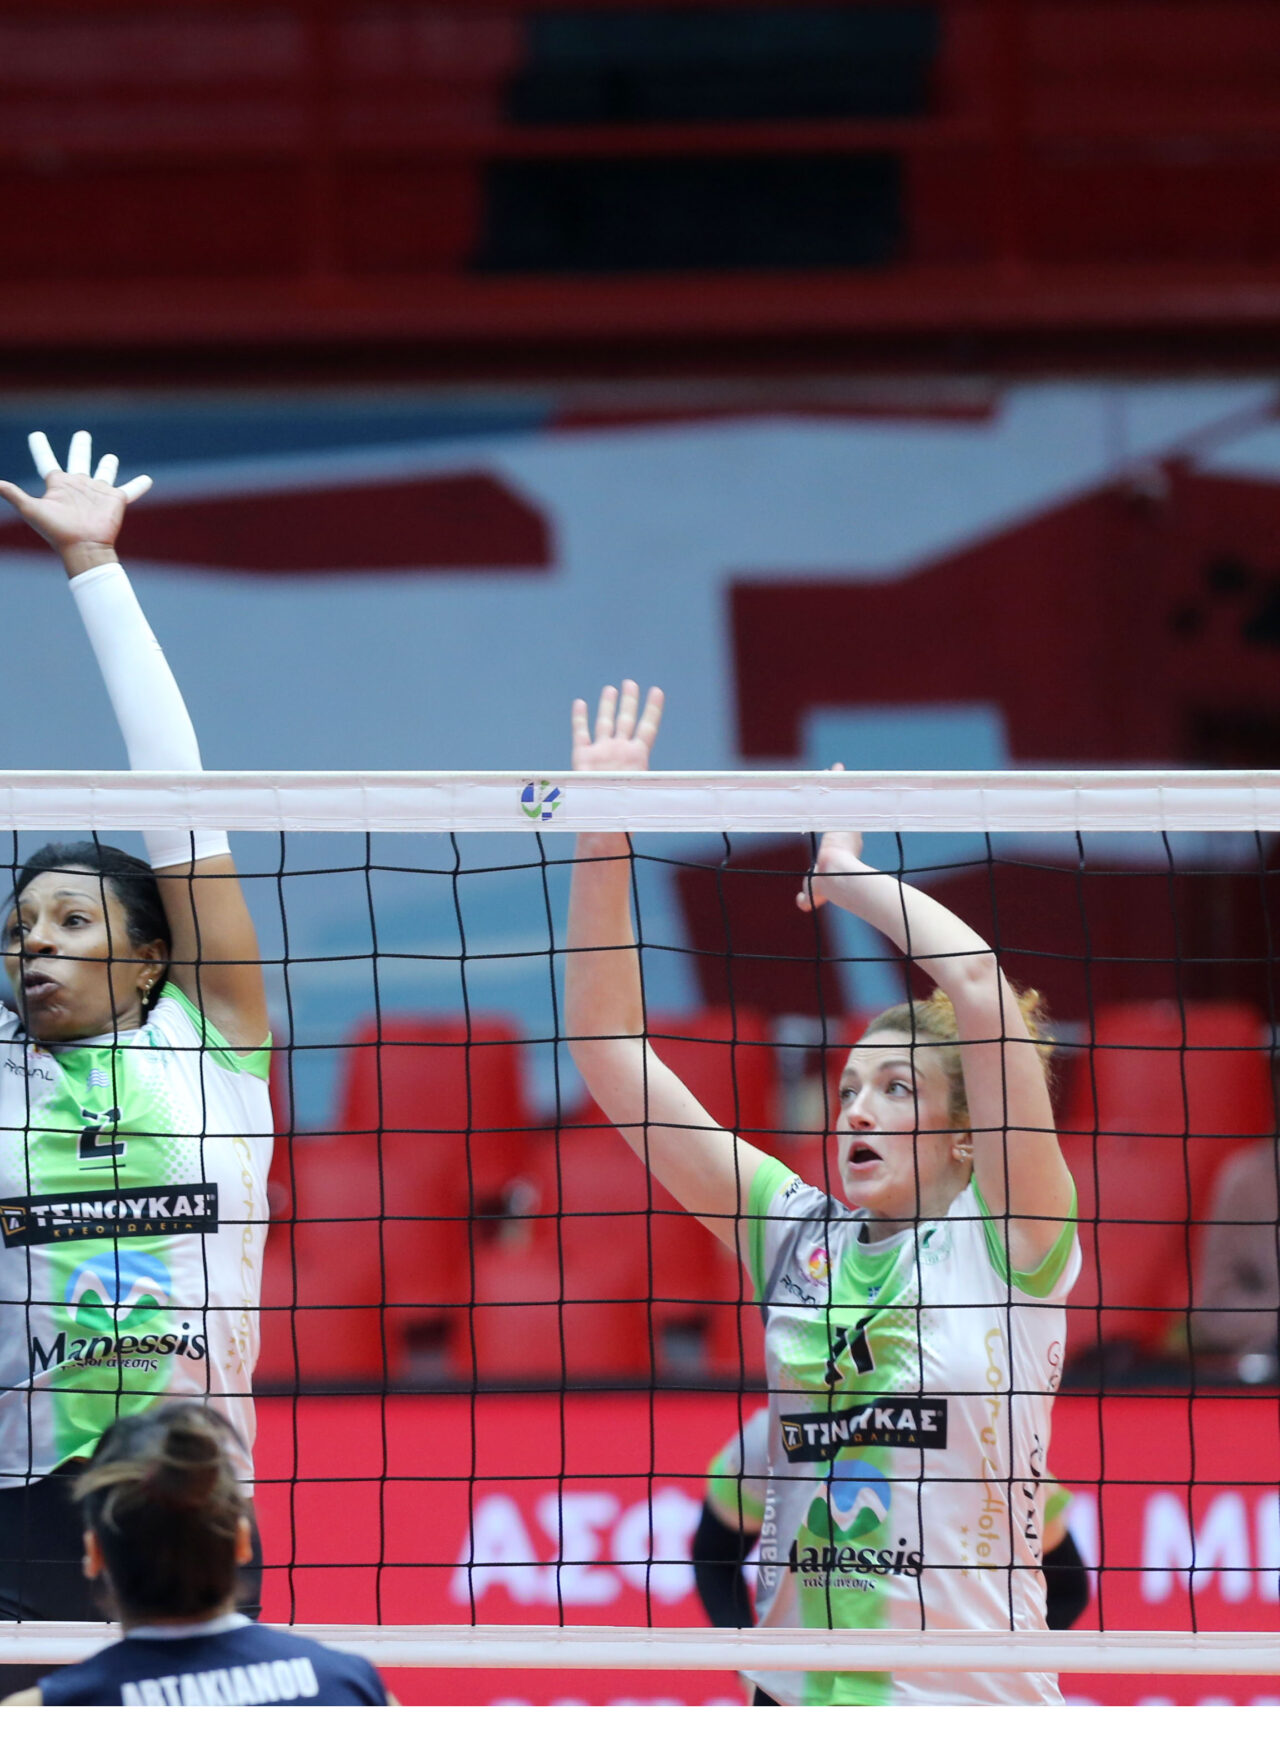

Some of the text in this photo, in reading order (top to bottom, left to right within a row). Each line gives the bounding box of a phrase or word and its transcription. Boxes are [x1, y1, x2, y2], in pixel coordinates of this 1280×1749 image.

[78, 1107, 127, 1160] 2
[30, 1194, 211, 1227] ΤΣΙΝΟΥΚΑΣ
[31, 1322, 207, 1372] Manessis
[122, 1657, 319, 1706] ARTAKIANOU
